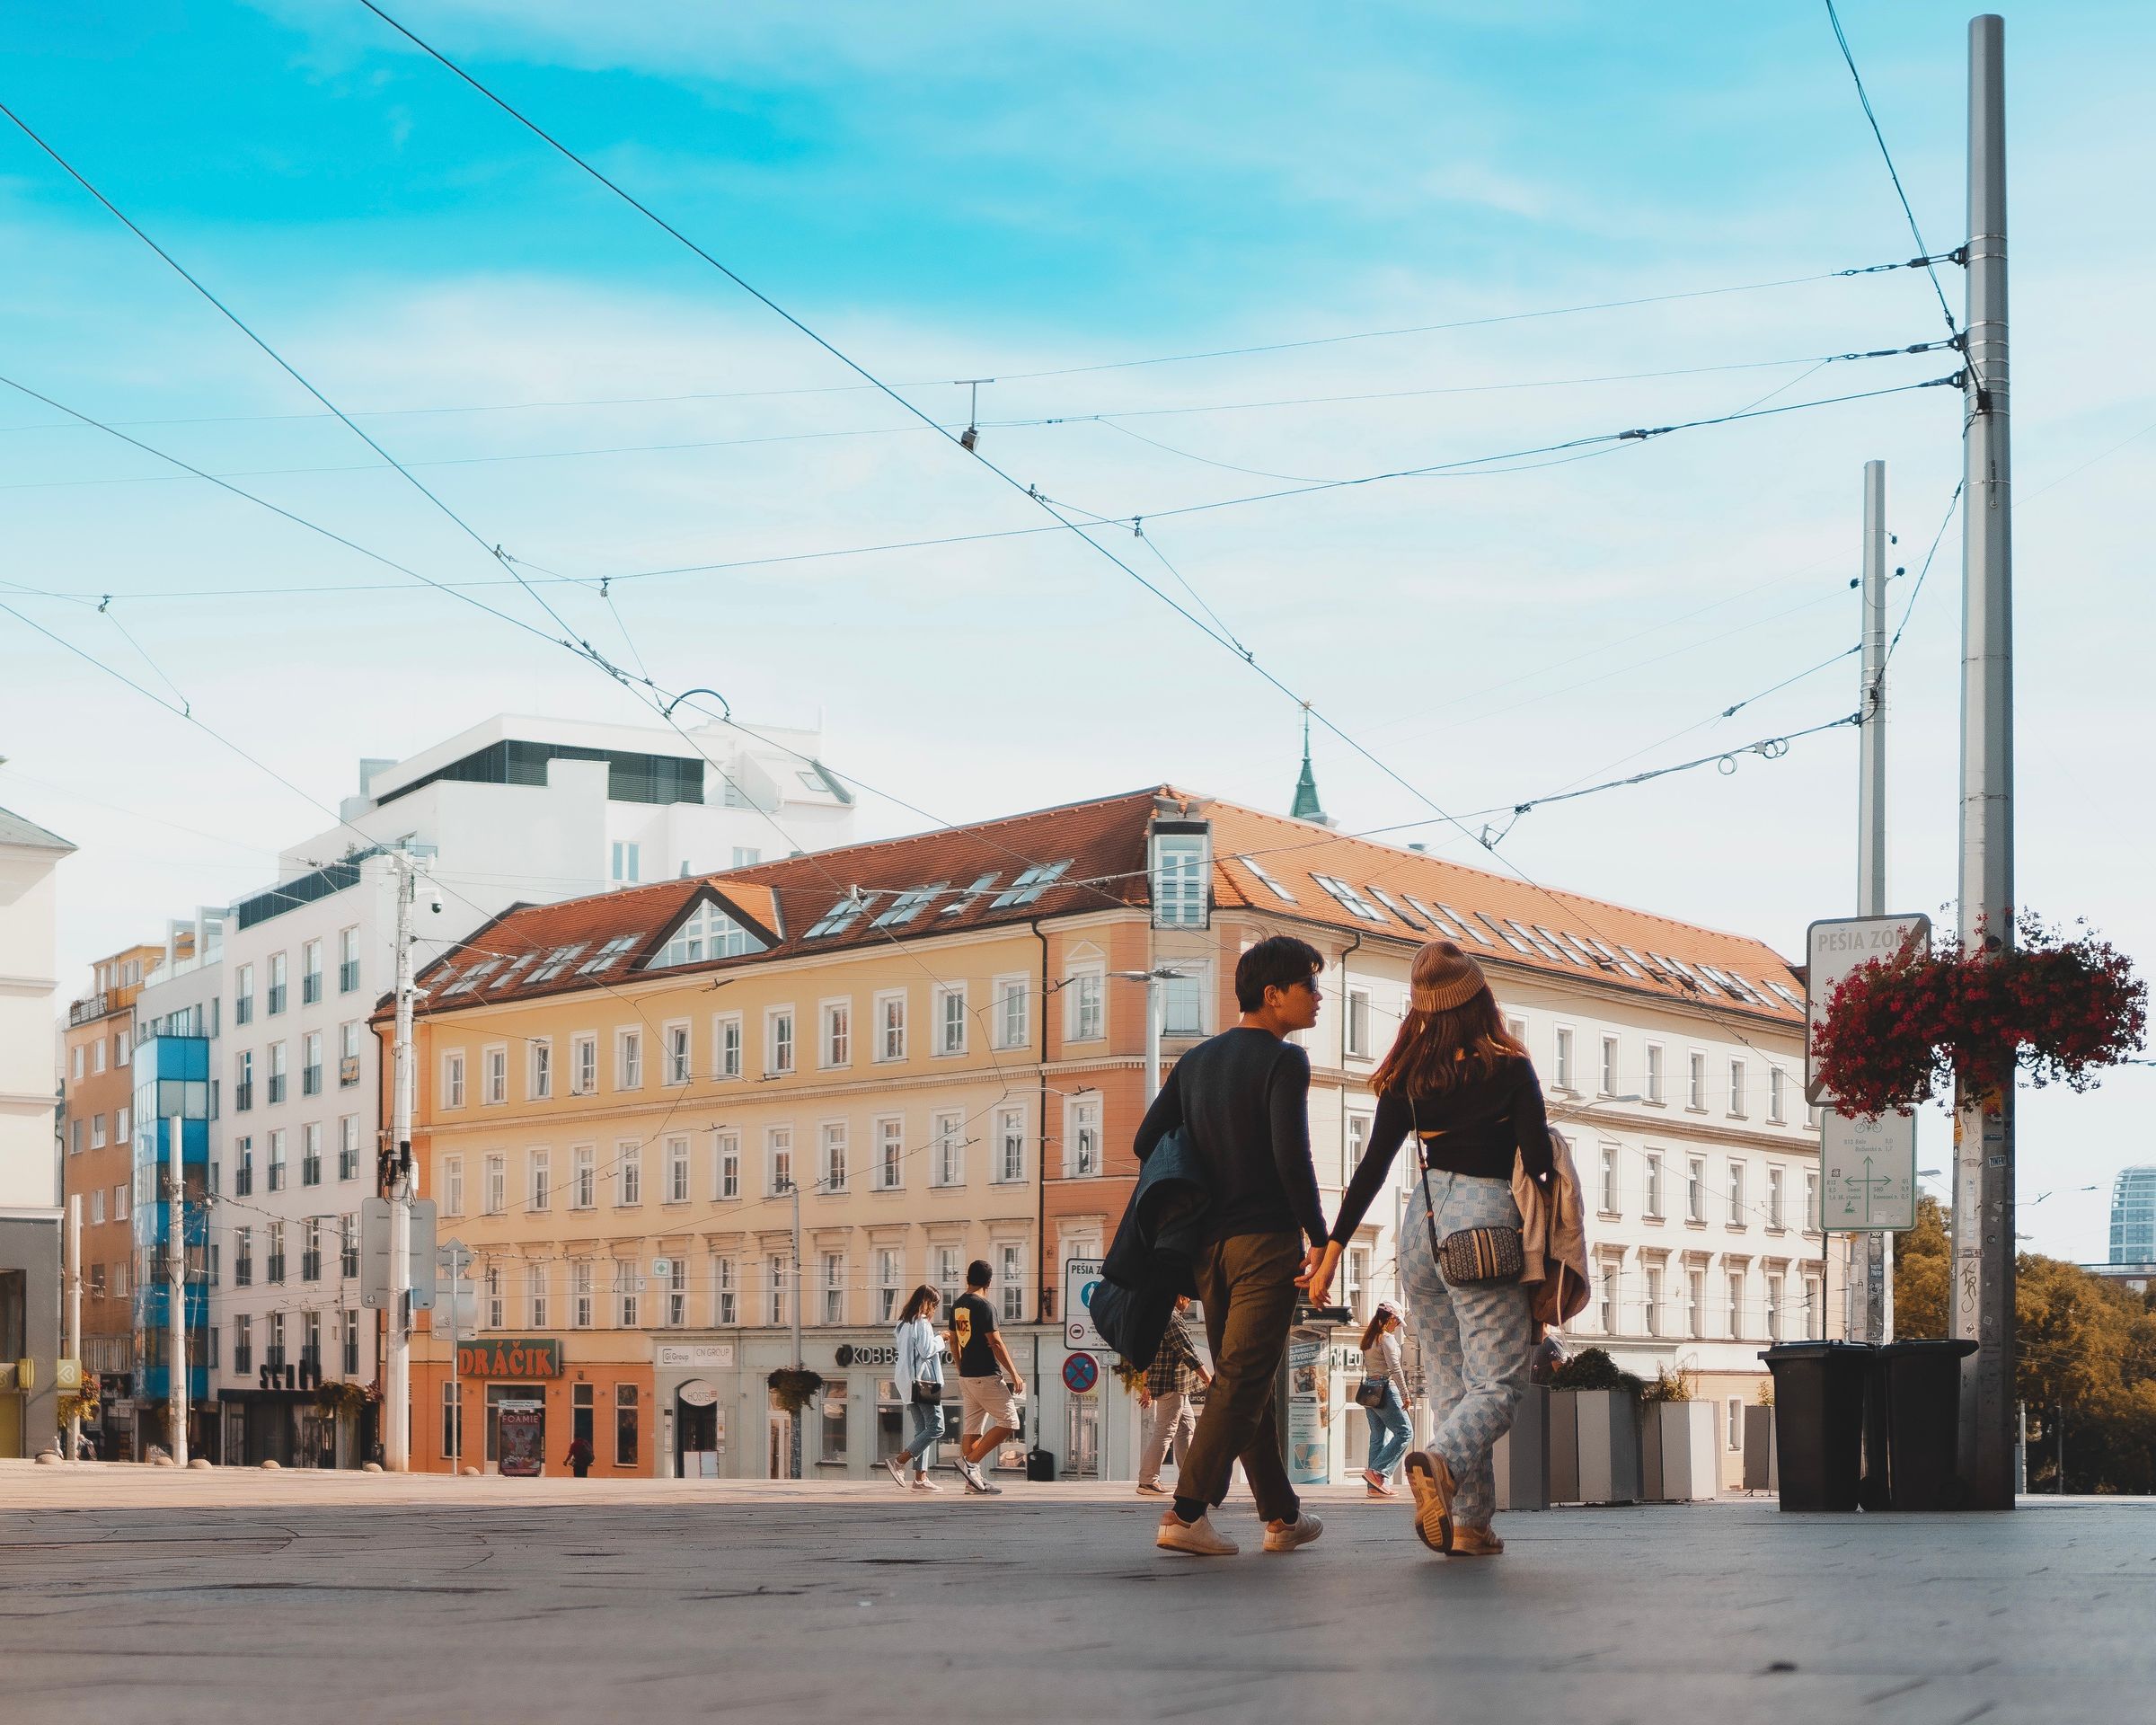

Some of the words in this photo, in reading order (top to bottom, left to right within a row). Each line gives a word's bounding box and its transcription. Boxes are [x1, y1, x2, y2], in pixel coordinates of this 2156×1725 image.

[1818, 927, 1864, 952] PEŠIA
[1870, 925, 1903, 949] ZÓ
[1072, 1263, 1094, 1275] PEŠIA
[458, 1340, 553, 1376] DRÁČIK
[672, 1352, 689, 1362] Group
[707, 1348, 729, 1357] GROUP
[853, 1347, 882, 1364] KDB
[884, 1347, 898, 1364] Ba
[687, 1391, 711, 1402] HOSTEL
[502, 1415, 539, 1423] FOAMIE
